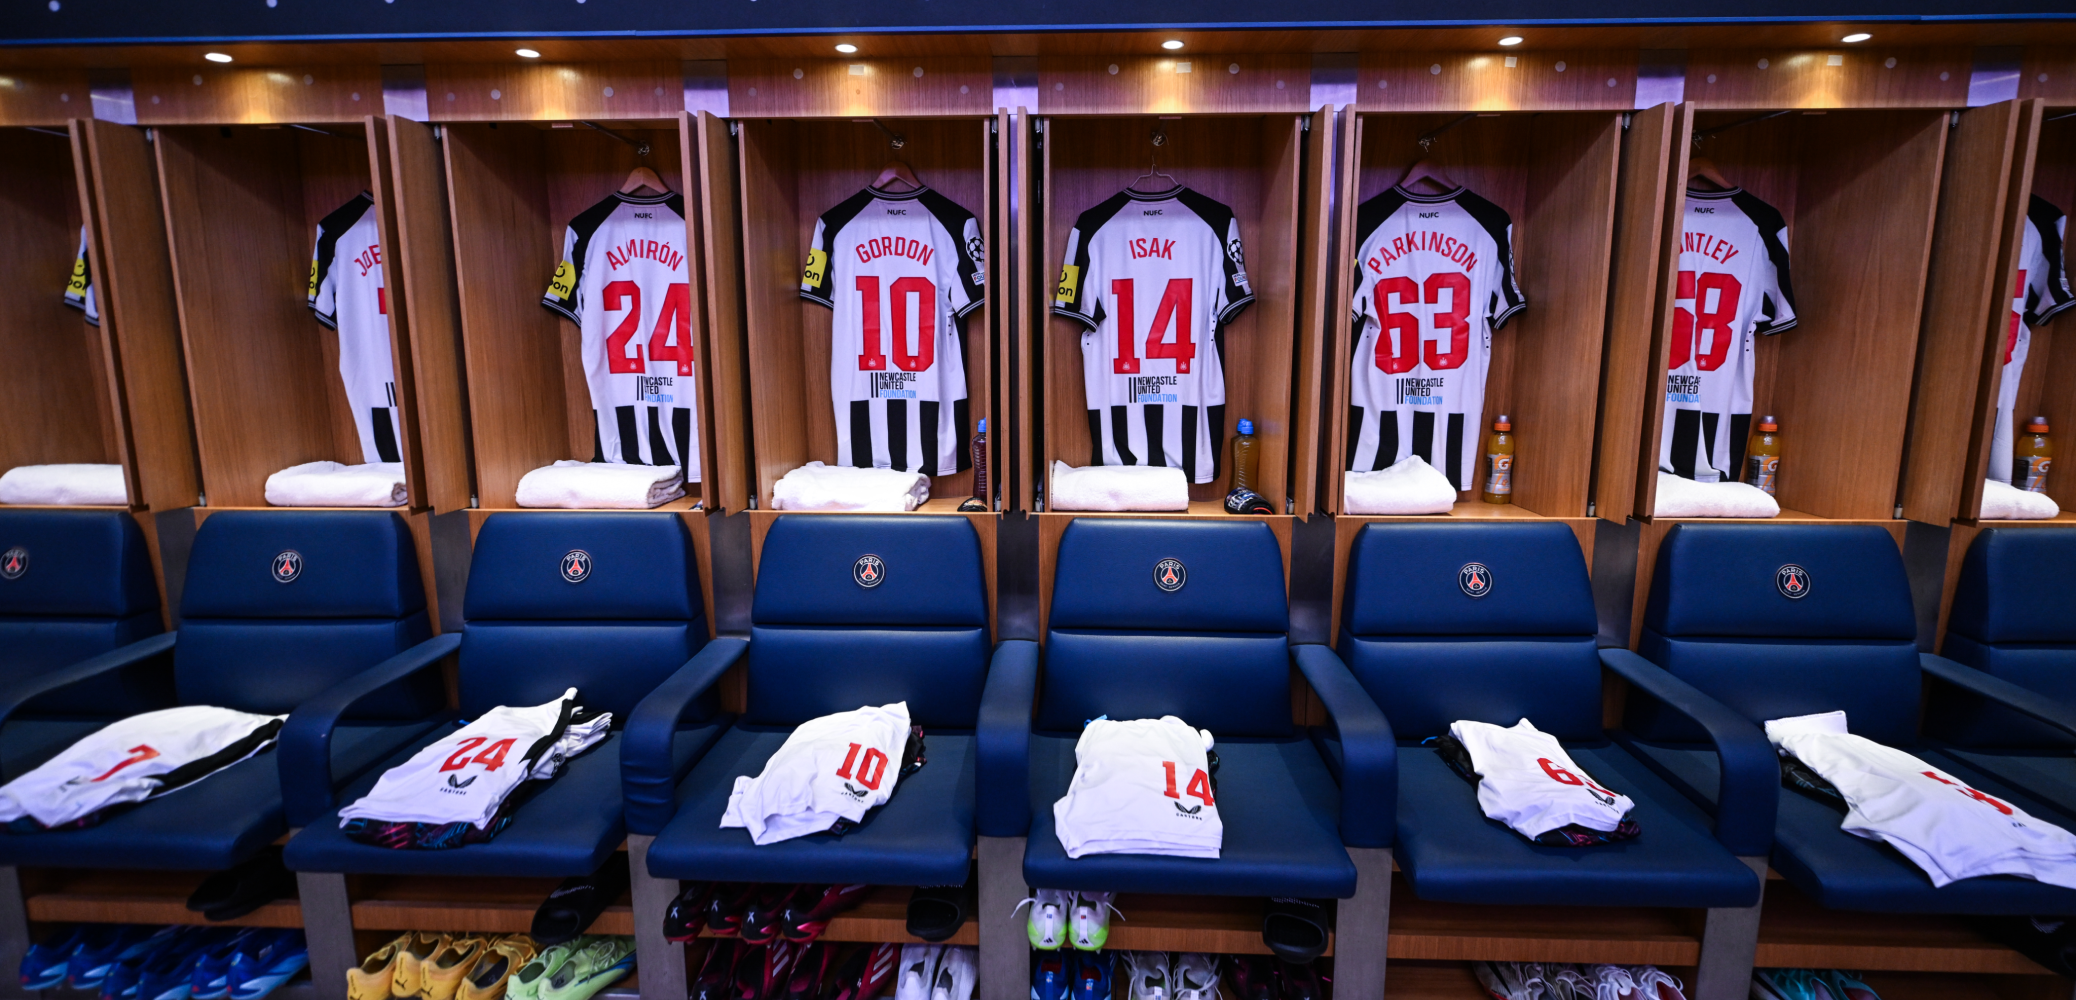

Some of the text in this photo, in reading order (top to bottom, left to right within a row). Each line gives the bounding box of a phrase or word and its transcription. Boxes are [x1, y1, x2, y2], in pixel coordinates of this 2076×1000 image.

[1143, 209, 1163, 217] NUFC
[1418, 211, 1440, 219] NUFC
[1694, 206, 1715, 214] NUFC
[634, 212, 653, 220] NUFC
[855, 236, 934, 267] GORDON
[1128, 237, 1176, 261] ISAK
[1367, 230, 1478, 275] PARKINSON
[1680, 231, 1739, 265] NTLEY
[605, 238, 684, 272] ALMIRÓN
[602, 280, 695, 377] 24
[855, 275, 936, 372] 10
[1111, 277, 1196, 375] 14
[1373, 272, 1471, 375] 63
[879, 372, 916, 382] NEWCASTLE
[1137, 376, 1178, 386] NEWCASTLE
[879, 380, 904, 390] UNITED
[1405, 378, 1444, 388] NEWCASTLE
[879, 389, 917, 399] FOUNDATION
[1137, 385, 1161, 395] UNITED
[1405, 387, 1431, 397] UNITED
[1667, 384, 1698, 395] UNITED
[1137, 394, 1178, 403] FOUNDATION
[1404, 396, 1443, 405] FOUNDATION
[438, 736, 519, 773] 24
[91, 744, 161, 782] 7
[836, 742, 888, 790] 10
[1162, 761, 1215, 806] 14
